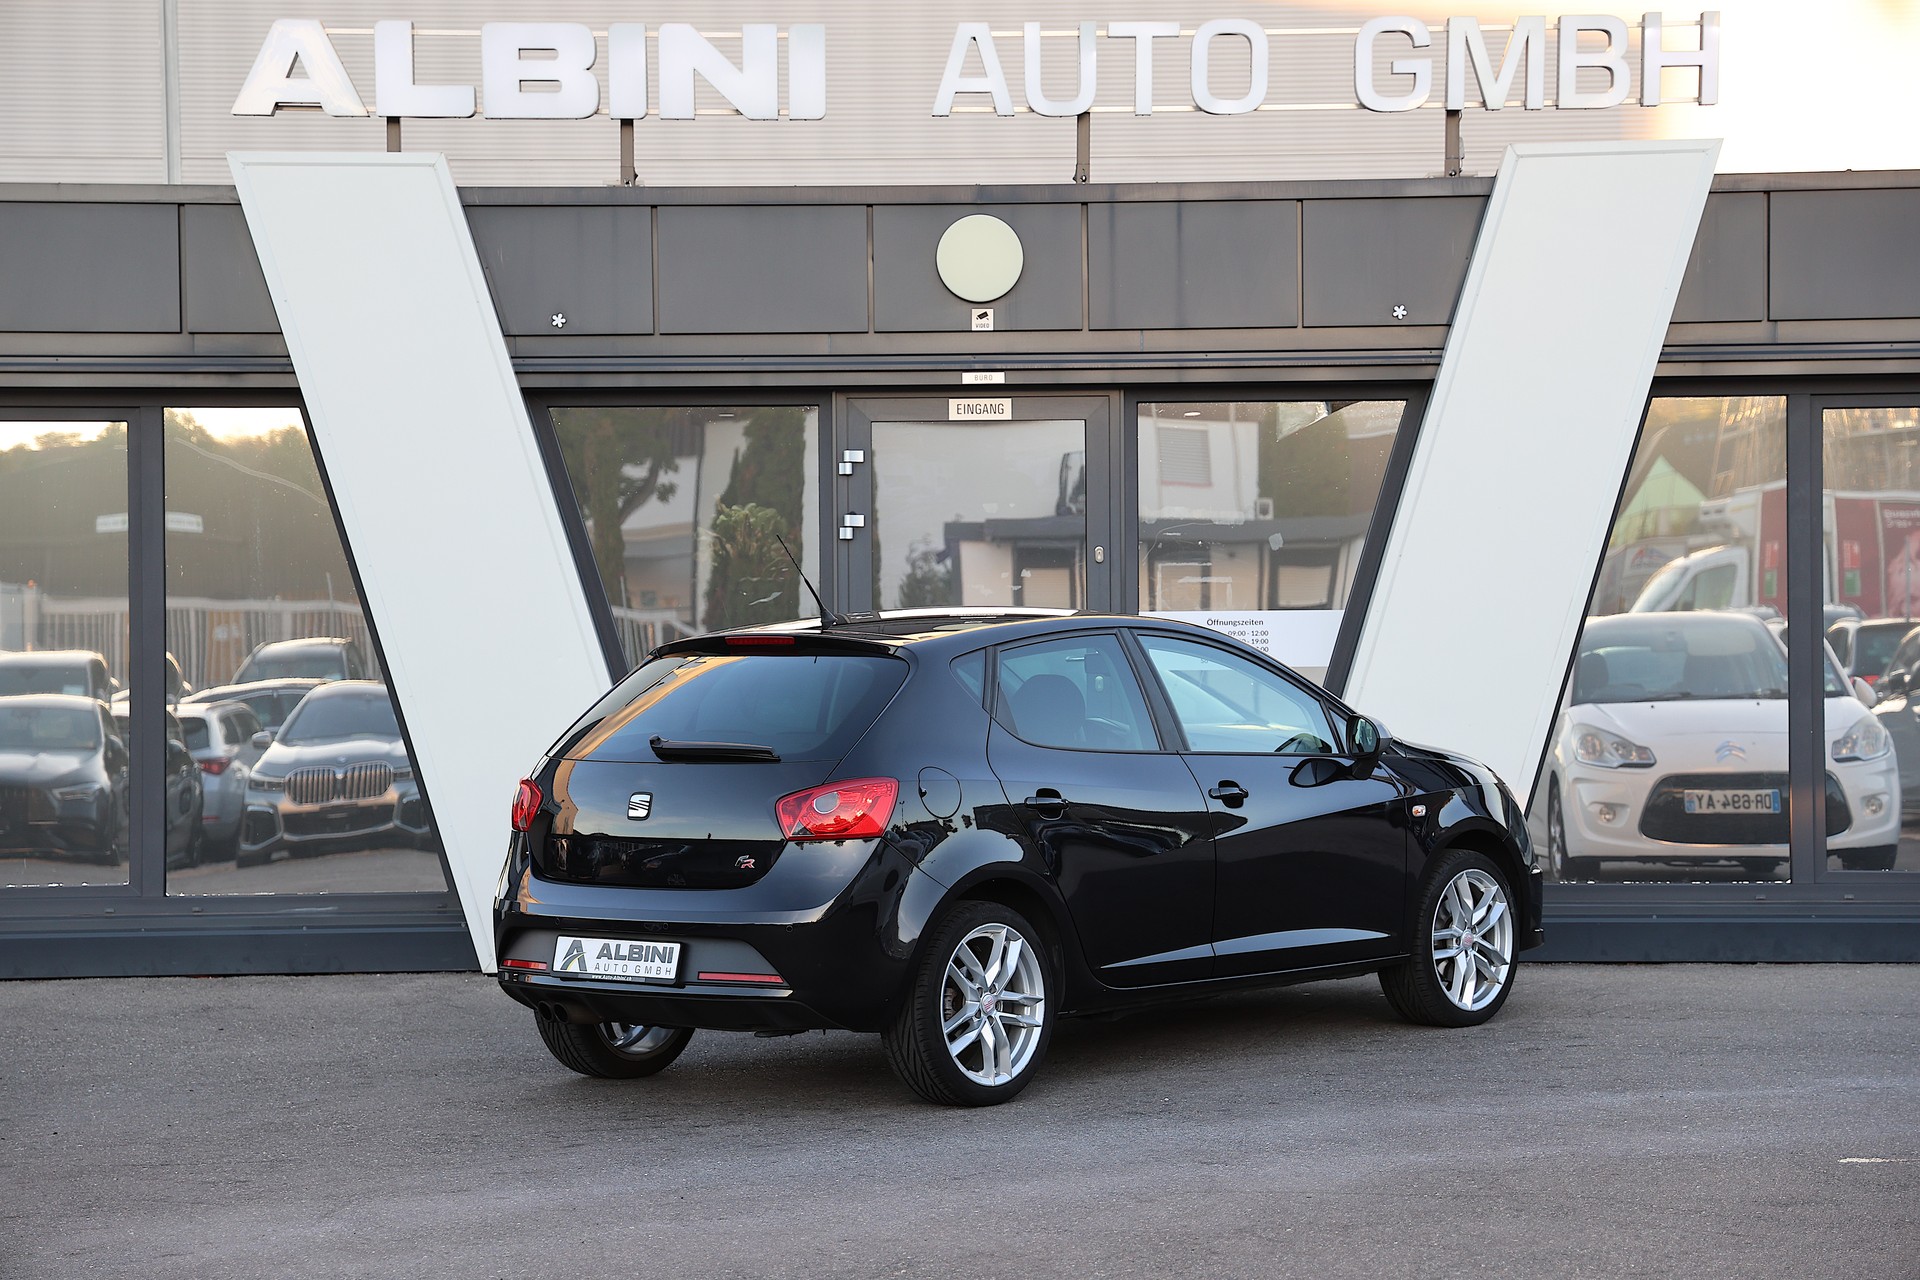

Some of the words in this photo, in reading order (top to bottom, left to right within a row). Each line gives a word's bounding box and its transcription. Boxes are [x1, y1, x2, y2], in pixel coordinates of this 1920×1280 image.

[231, 19, 827, 120] ALBINI
[932, 18, 1269, 118] AUTO
[1353, 11, 1722, 112] GMBH
[956, 403, 1005, 415] EINGANG
[1206, 617, 1264, 627] Öffnungszeiten
[596, 942, 675, 964] ALBINI
[594, 962, 628, 973] AUTO
[634, 964, 672, 976] GMBH
